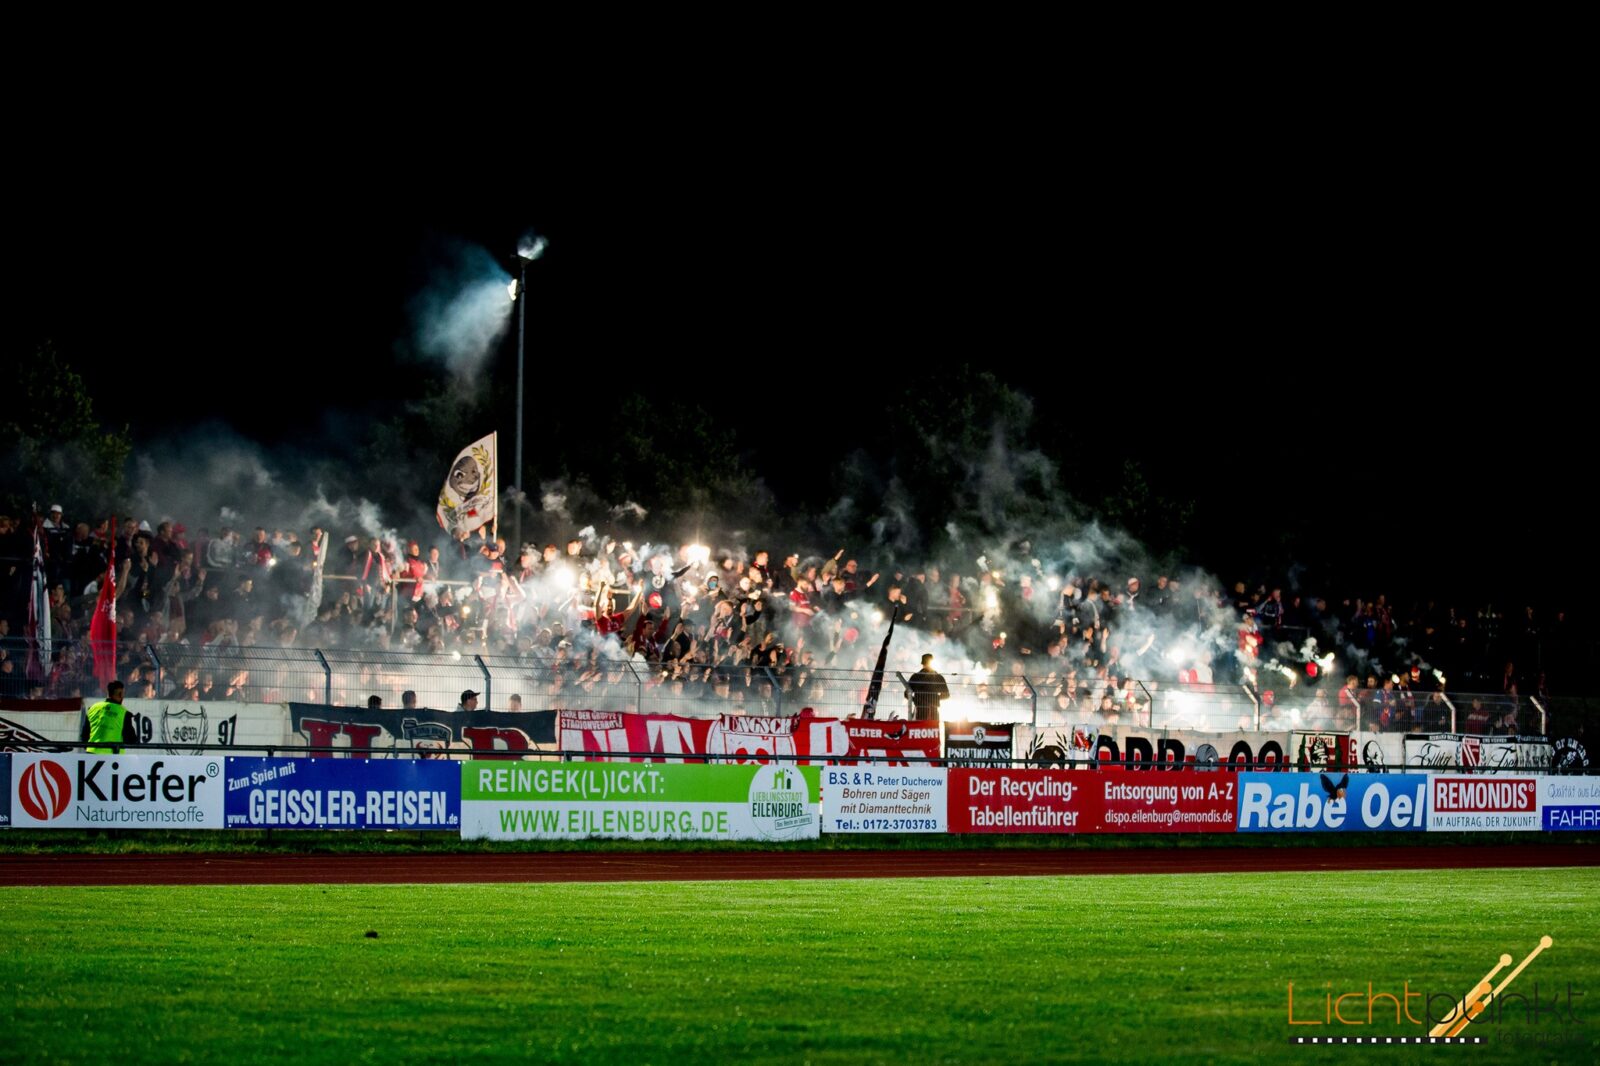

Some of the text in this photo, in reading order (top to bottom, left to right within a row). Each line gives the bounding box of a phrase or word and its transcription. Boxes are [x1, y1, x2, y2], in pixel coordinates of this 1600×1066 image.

[849, 727, 940, 739] ELSTER FRONT
[228, 762, 296, 792] Zum Spiel mit
[479, 769, 665, 799] REINGEK(L)ICKT:
[829, 772, 943, 786] B.S. & R. Peter Ducherow
[752, 791, 803, 802] LIEBLINGSSTADT
[842, 788, 930, 802] Bohren und Sägen
[969, 776, 1078, 801] Der Recycling-
[1104, 782, 1233, 805] Entsorgung von A-Z
[1547, 784, 1576, 799] Qualität
[1577, 787, 1590, 798] aus
[76, 805, 204, 822] Naturbrennstoffe
[227, 789, 458, 825] www.GEISSLER-REISEN.de
[752, 803, 803, 818] EILENBURG
[840, 803, 932, 814] mit Diamanttechnik
[1239, 782, 1426, 829] Rabe Oel
[500, 810, 728, 833] WWW.EILENBURG.DE
[968, 805, 1079, 826] Tabellenführer
[1105, 809, 1233, 826] dispo.eilenburg@remondis.de
[1433, 816, 1537, 827] IM AUFTRAG DER ZUKUNFT
[835, 820, 937, 830] Tel.: 0172-3703783
